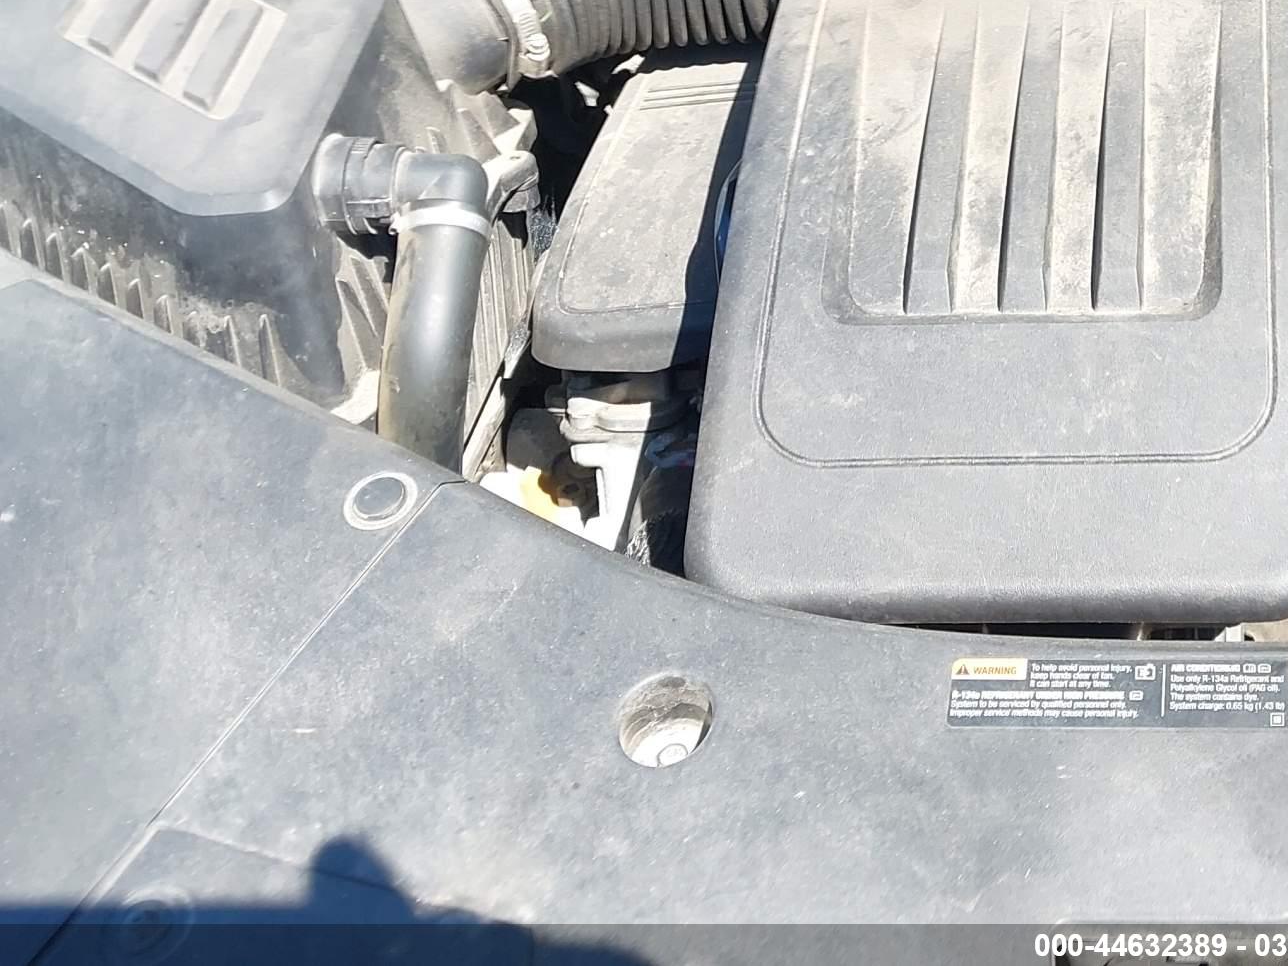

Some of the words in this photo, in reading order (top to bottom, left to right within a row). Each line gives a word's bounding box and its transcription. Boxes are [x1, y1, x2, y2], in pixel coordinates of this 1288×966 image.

[974, 666, 1017, 675] WARNING
[1032, 664, 1040, 673] To
[1042, 664, 1057, 673] help
[1058, 664, 1077, 673] avoid
[1079, 664, 1109, 673] personal
[1111, 664, 1132, 673] injury.
[1031, 672, 1048, 680] keep
[1050, 672, 1071, 680] hands
[1073, 672, 1091, 680] clear
[1092, 672, 1099, 680] of
[1171, 675, 1184, 683] Use
[1185, 675, 1201, 683] only
[1202, 675, 1228, 683] R-134a
[1271, 675, 1284, 683] and
[1037, 680, 1050, 688] can
[1051, 680, 1068, 688] start
[1069, 680, 1076, 688] at
[1078, 680, 1092, 688] any
[1093, 680, 1111, 688] time.
[1170, 684, 1214, 692] Polyalkylene
[1216, 684, 1237, 692] Glycol
[1239, 684, 1247, 692] oil
[1249, 684, 1266, 692] (PAG
[1170, 693, 1183, 701] The
[1185, 693, 1211, 701] system
[1212, 693, 1242, 701] contains
[1244, 693, 1259, 701] dye.
[951, 700, 978, 708] System
[979, 700, 987, 708] to
[988, 700, 998, 708] be
[999, 700, 1029, 708] serviced
[1031, 700, 1040, 708] by
[1042, 700, 1072, 708] qualified
[1073, 700, 1109, 708] personnel
[1110, 700, 1126, 708] only.
[1170, 702, 1196, 711] System
[1198, 702, 1224, 711] charge:
[1244, 702, 1253, 711] kg
[950, 709, 983, 717] Improper
[984, 709, 1010, 717] service
[1011, 709, 1043, 717] methods
[1044, 709, 1060, 717] may
[1061, 709, 1083, 717] cause
[1084, 709, 1115, 717] personal
[1117, 709, 1139, 717] injury.
